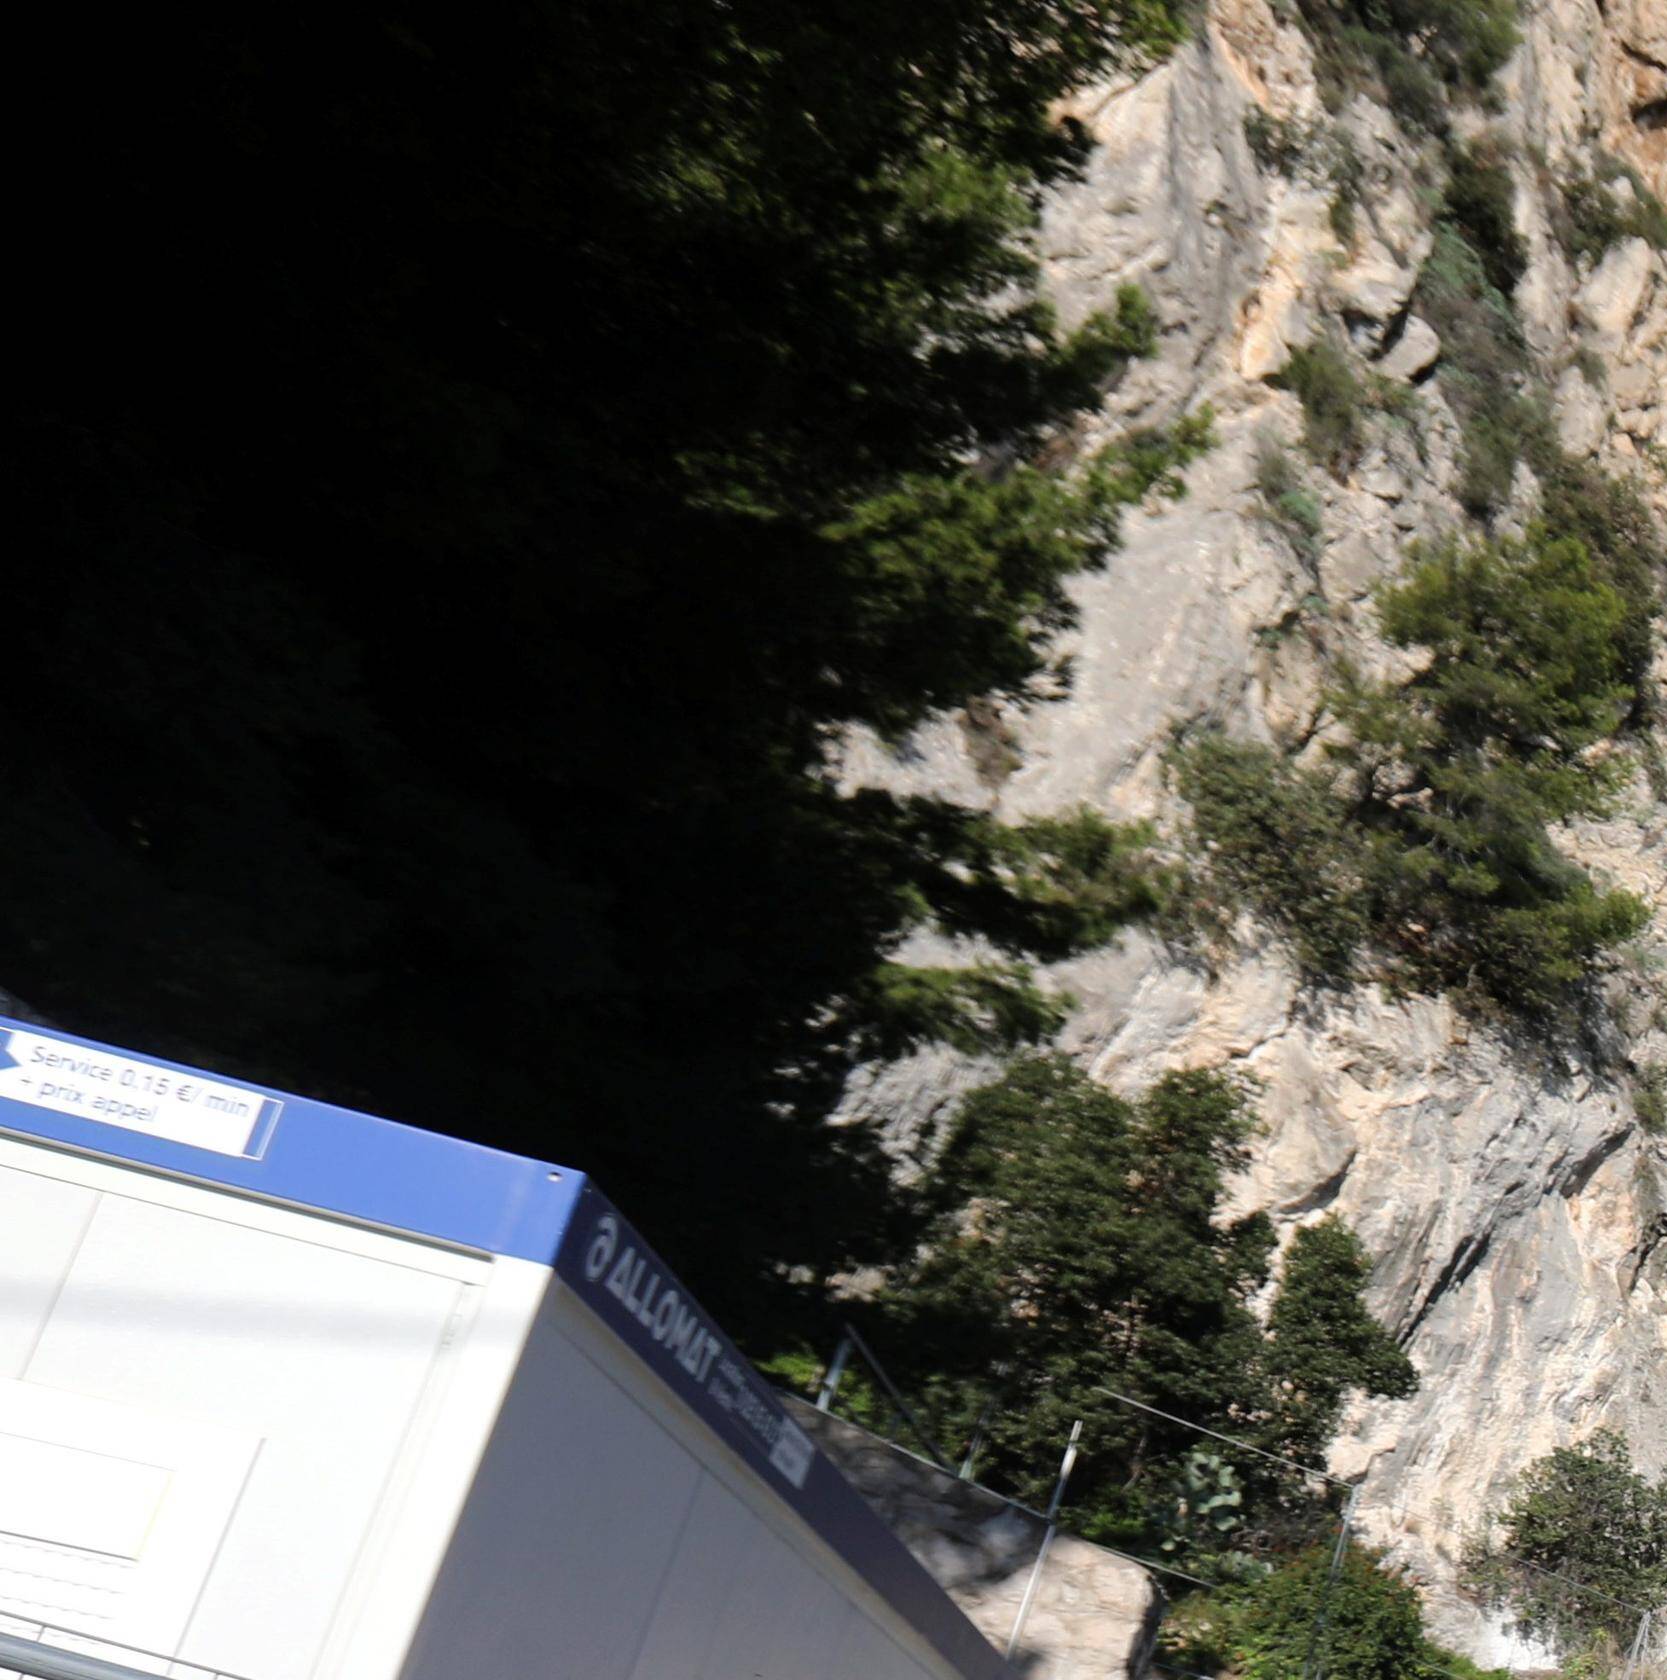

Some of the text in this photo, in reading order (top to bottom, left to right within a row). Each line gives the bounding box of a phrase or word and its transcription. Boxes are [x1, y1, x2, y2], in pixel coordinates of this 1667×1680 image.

[30, 1044, 114, 1082] Service
[37, 1081, 84, 1105] prix
[91, 1094, 159, 1124] appel
[604, 1246, 723, 1383] ALLOMAT
